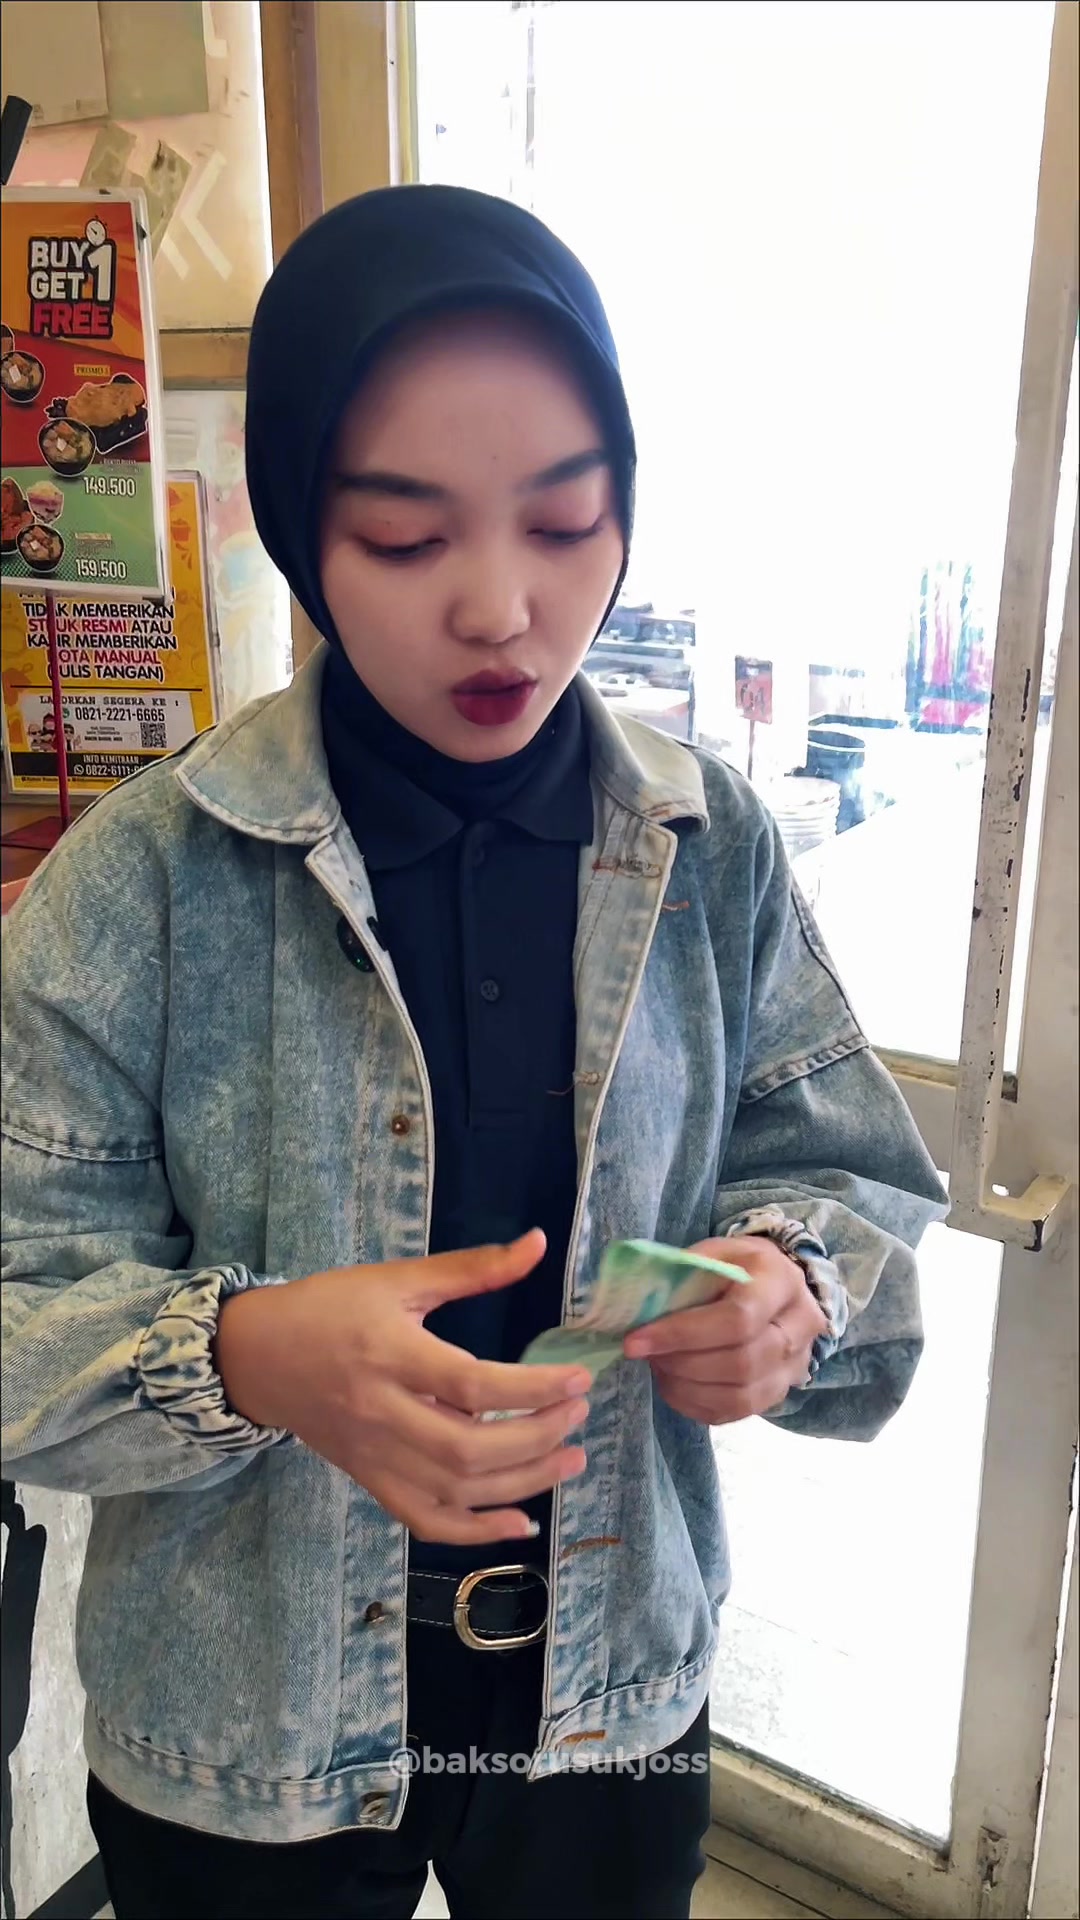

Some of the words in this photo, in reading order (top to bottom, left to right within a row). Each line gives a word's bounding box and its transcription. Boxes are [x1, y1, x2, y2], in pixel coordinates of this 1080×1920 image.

[31, 241, 89, 268] BUY
[87, 244, 112, 301] 1
[31, 271, 84, 299] GET
[33, 302, 110, 335] FREE
[83, 476, 136, 496] 149.500
[75, 558, 127, 579] 159.500
[23, 603, 68, 617] TIDK
[73, 603, 174, 618] MEMBERIKAN
[28, 618, 78, 632] STUK
[82, 619, 127, 633] RESMI
[131, 620, 172, 634] ATAU
[27, 633, 71, 647] KAIR
[76, 635, 177, 649] MEMBERIKAN
[94, 650, 161, 664] MANUAL
[48, 664, 91, 680] (ULIS
[95, 665, 163, 682] TANGAN)
[39, 695, 96, 705] LAORKAN
[103, 696, 145, 706] SEGERA
[152, 697, 166, 706] KE
[75, 706, 165, 721] 0821-2221-6665
